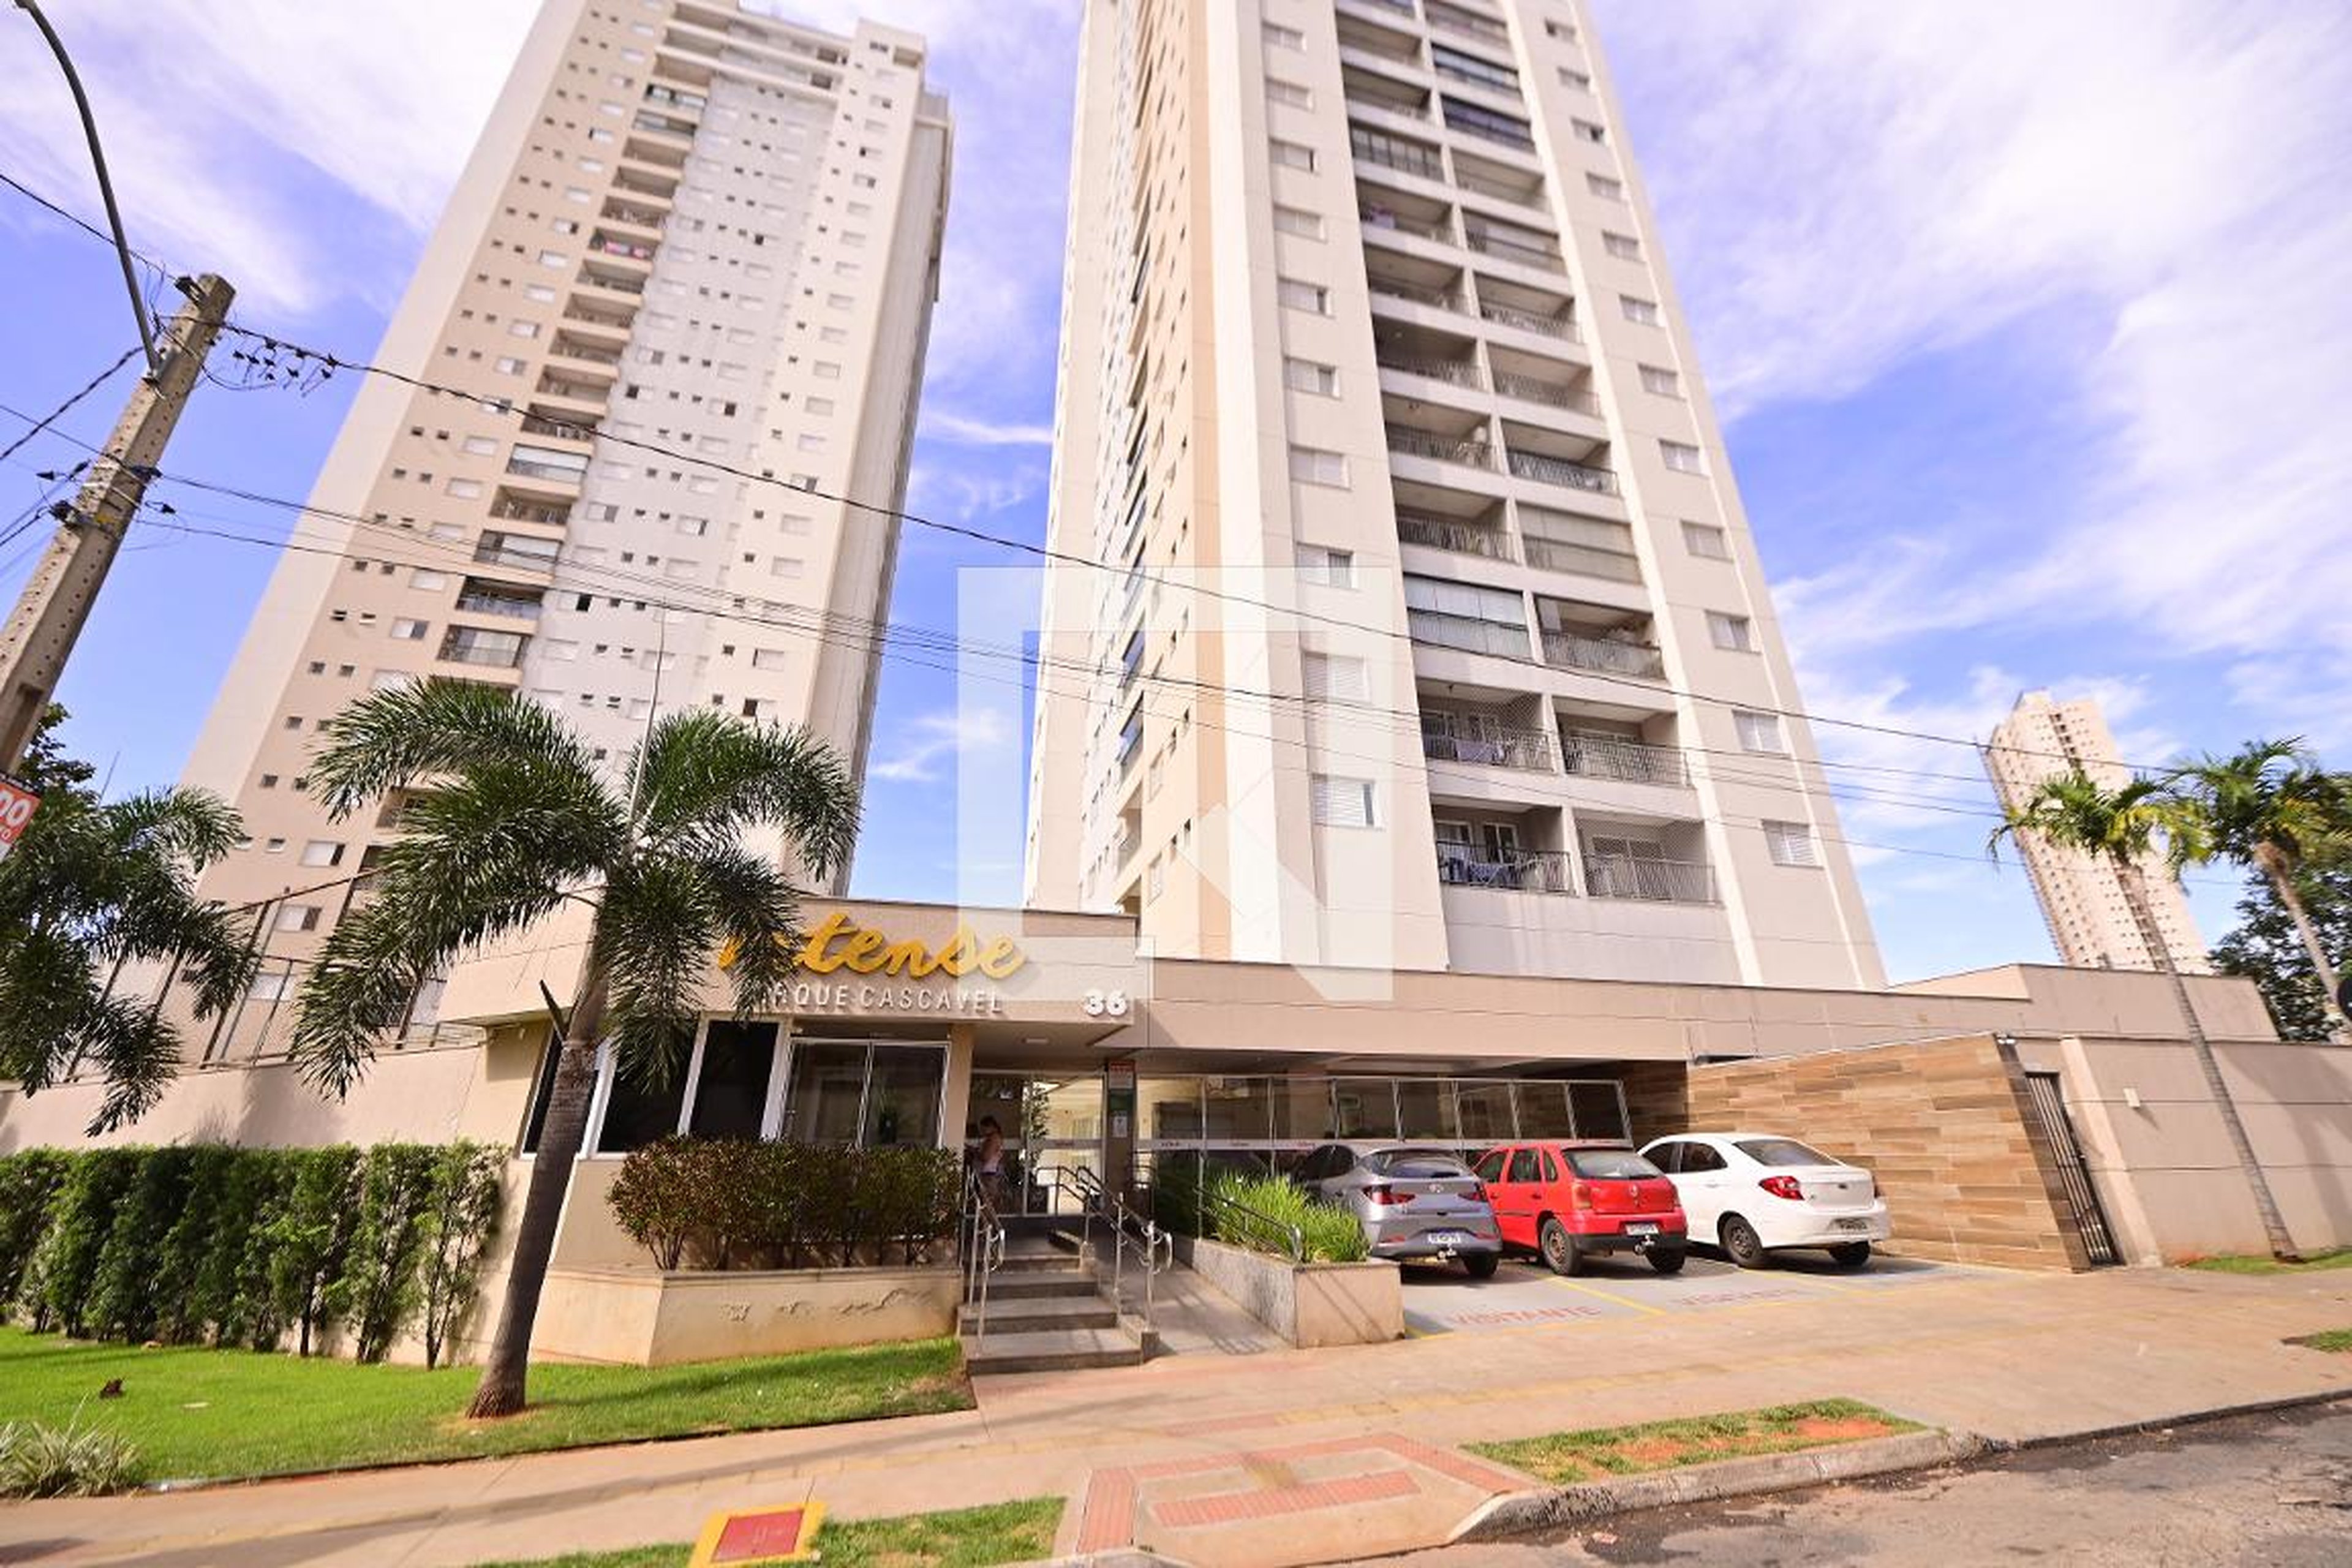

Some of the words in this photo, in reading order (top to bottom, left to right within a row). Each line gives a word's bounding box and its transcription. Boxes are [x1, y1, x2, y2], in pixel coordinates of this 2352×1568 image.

[718, 912, 1026, 980] tense
[859, 987, 1003, 1014] CASCAVEL
[1082, 988, 1128, 1016] 36
